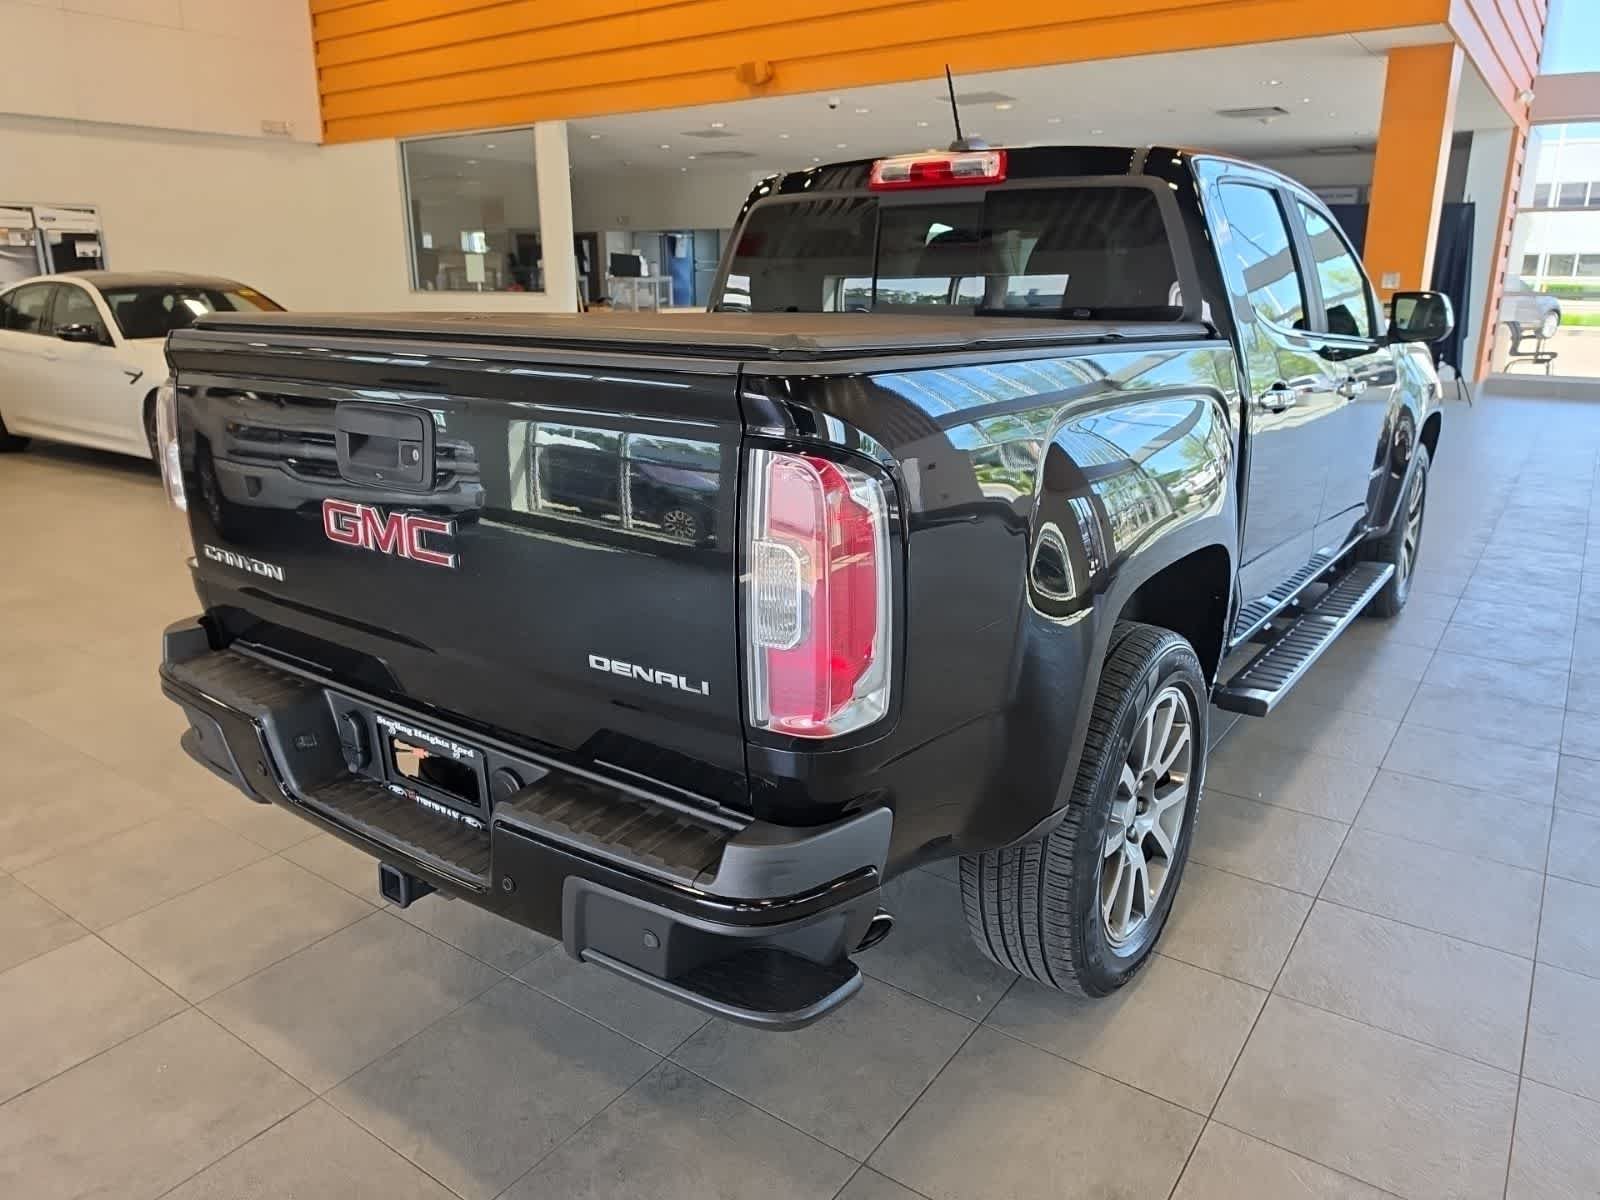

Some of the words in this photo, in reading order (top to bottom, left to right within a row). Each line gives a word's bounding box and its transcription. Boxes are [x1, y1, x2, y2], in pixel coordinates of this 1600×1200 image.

[323, 498, 460, 568] GMC
[203, 544, 284, 582] CANYON
[588, 654, 710, 696] DENALI
[414, 728, 450, 748] Heights
